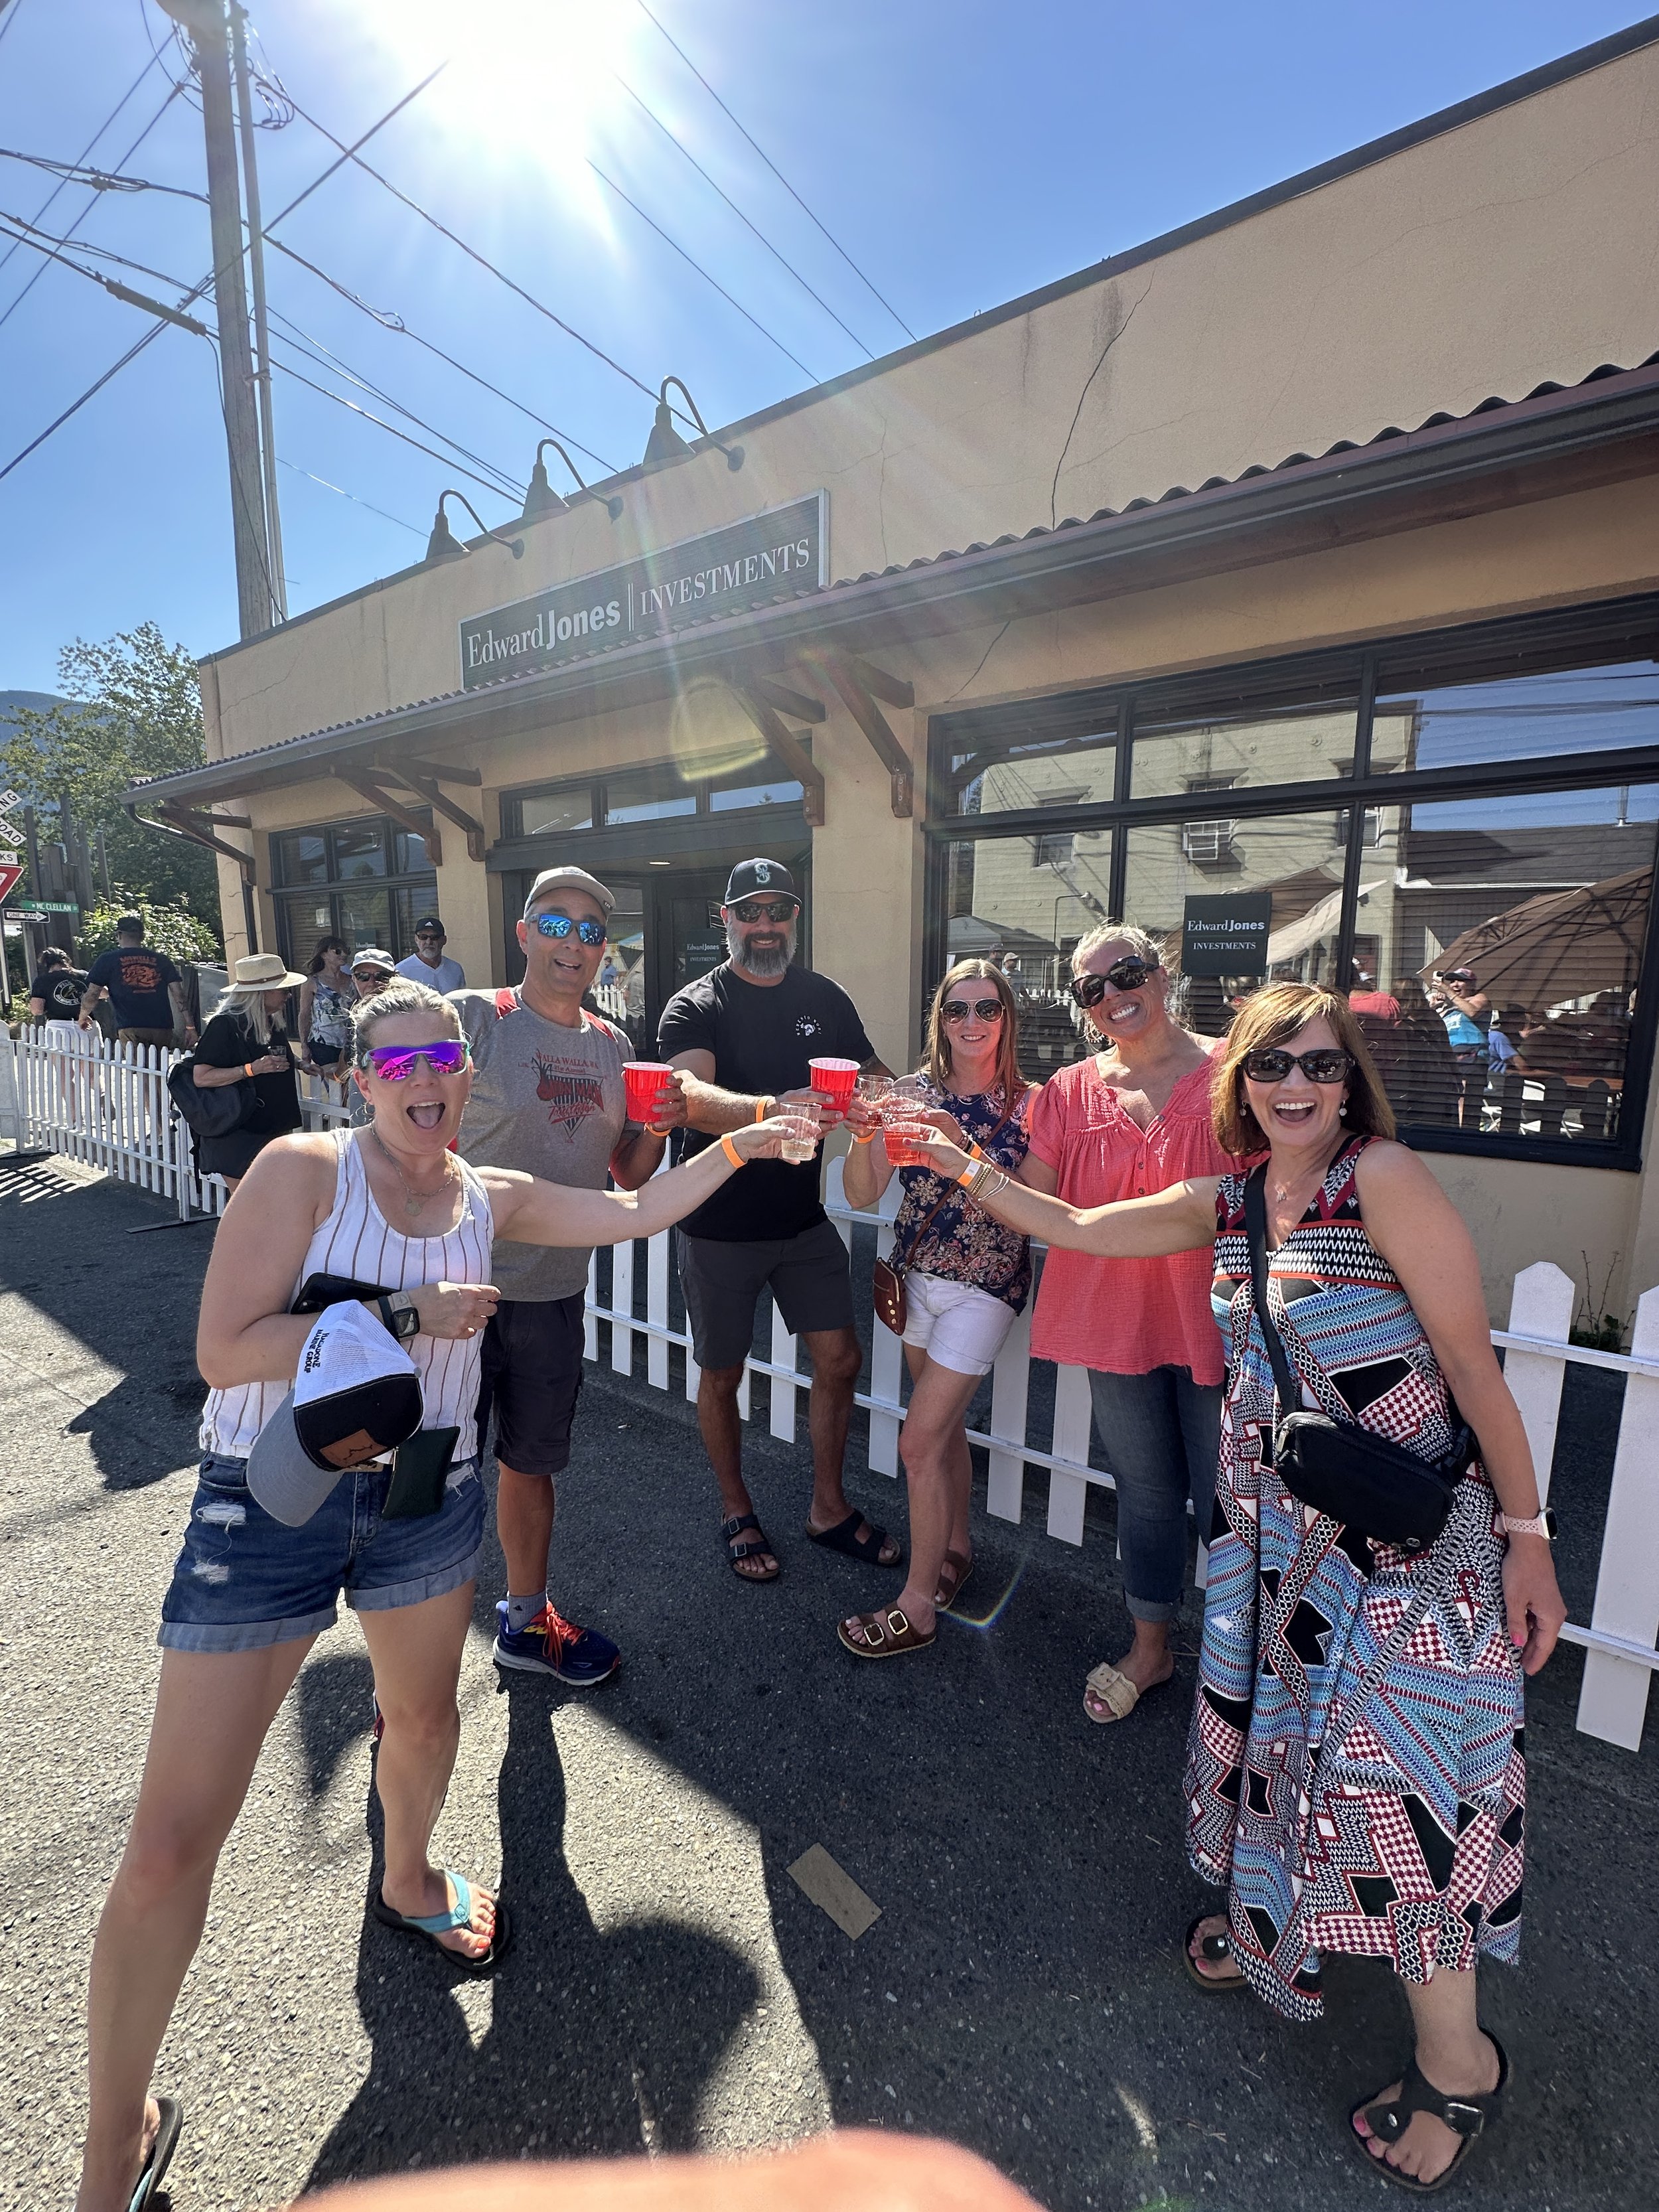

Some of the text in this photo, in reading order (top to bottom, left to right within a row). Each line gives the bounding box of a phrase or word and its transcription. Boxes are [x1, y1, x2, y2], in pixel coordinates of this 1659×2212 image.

[640, 538, 810, 616] INVESTMENTS
[535, 1052, 560, 1064] WALLA
[304, 1351, 315, 1373] GROUP
